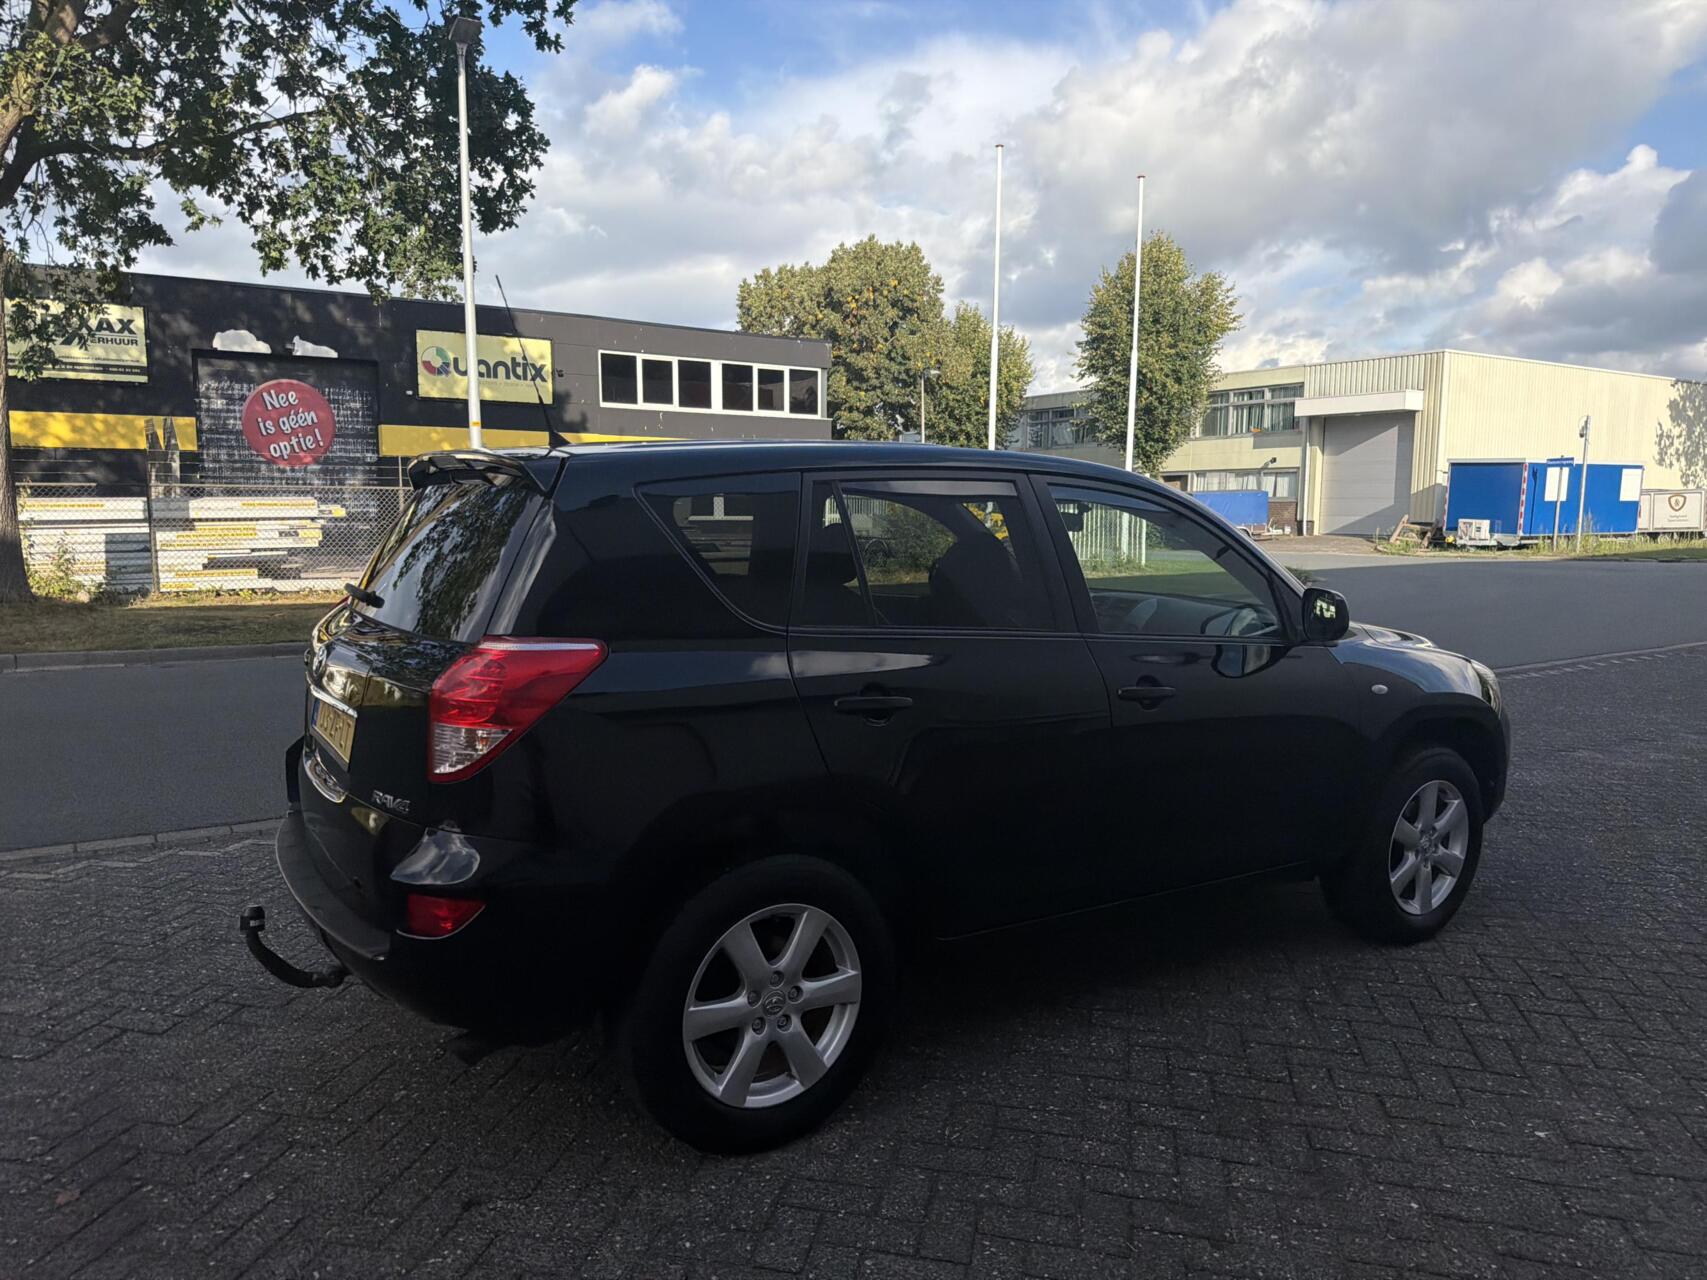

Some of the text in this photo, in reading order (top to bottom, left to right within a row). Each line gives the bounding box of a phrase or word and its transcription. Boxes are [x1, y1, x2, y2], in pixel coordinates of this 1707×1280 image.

[262, 389, 299, 410] Nee
[257, 407, 318, 436] is géén
[269, 428, 324, 460] optie!
